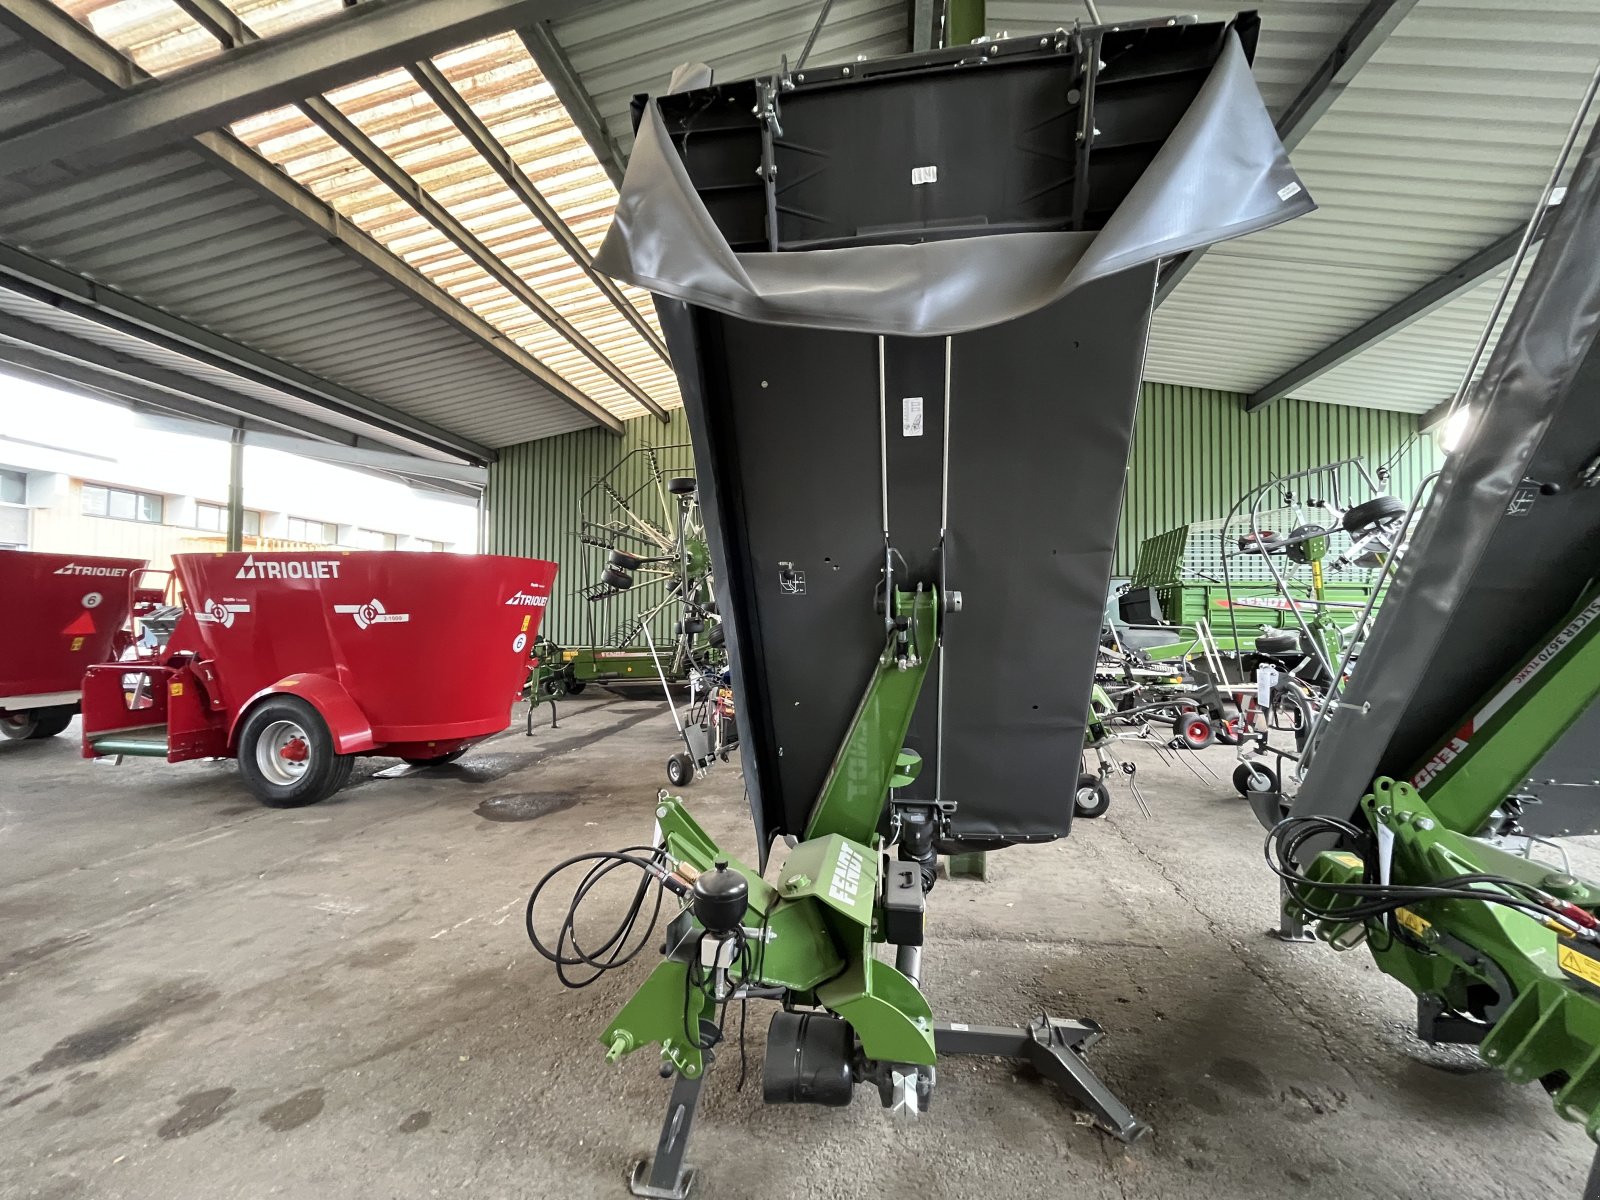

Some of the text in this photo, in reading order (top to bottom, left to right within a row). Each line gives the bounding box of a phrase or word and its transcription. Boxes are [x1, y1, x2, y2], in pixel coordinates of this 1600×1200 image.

[73, 565, 127, 577] TRIOLIET
[255, 561, 340, 579] TRIOLIET
[1562, 601, 1600, 639] SLICER
[1538, 635, 1567, 663] 3670
[1410, 736, 1470, 792] FEND
[828, 841, 863, 907] FENDT
